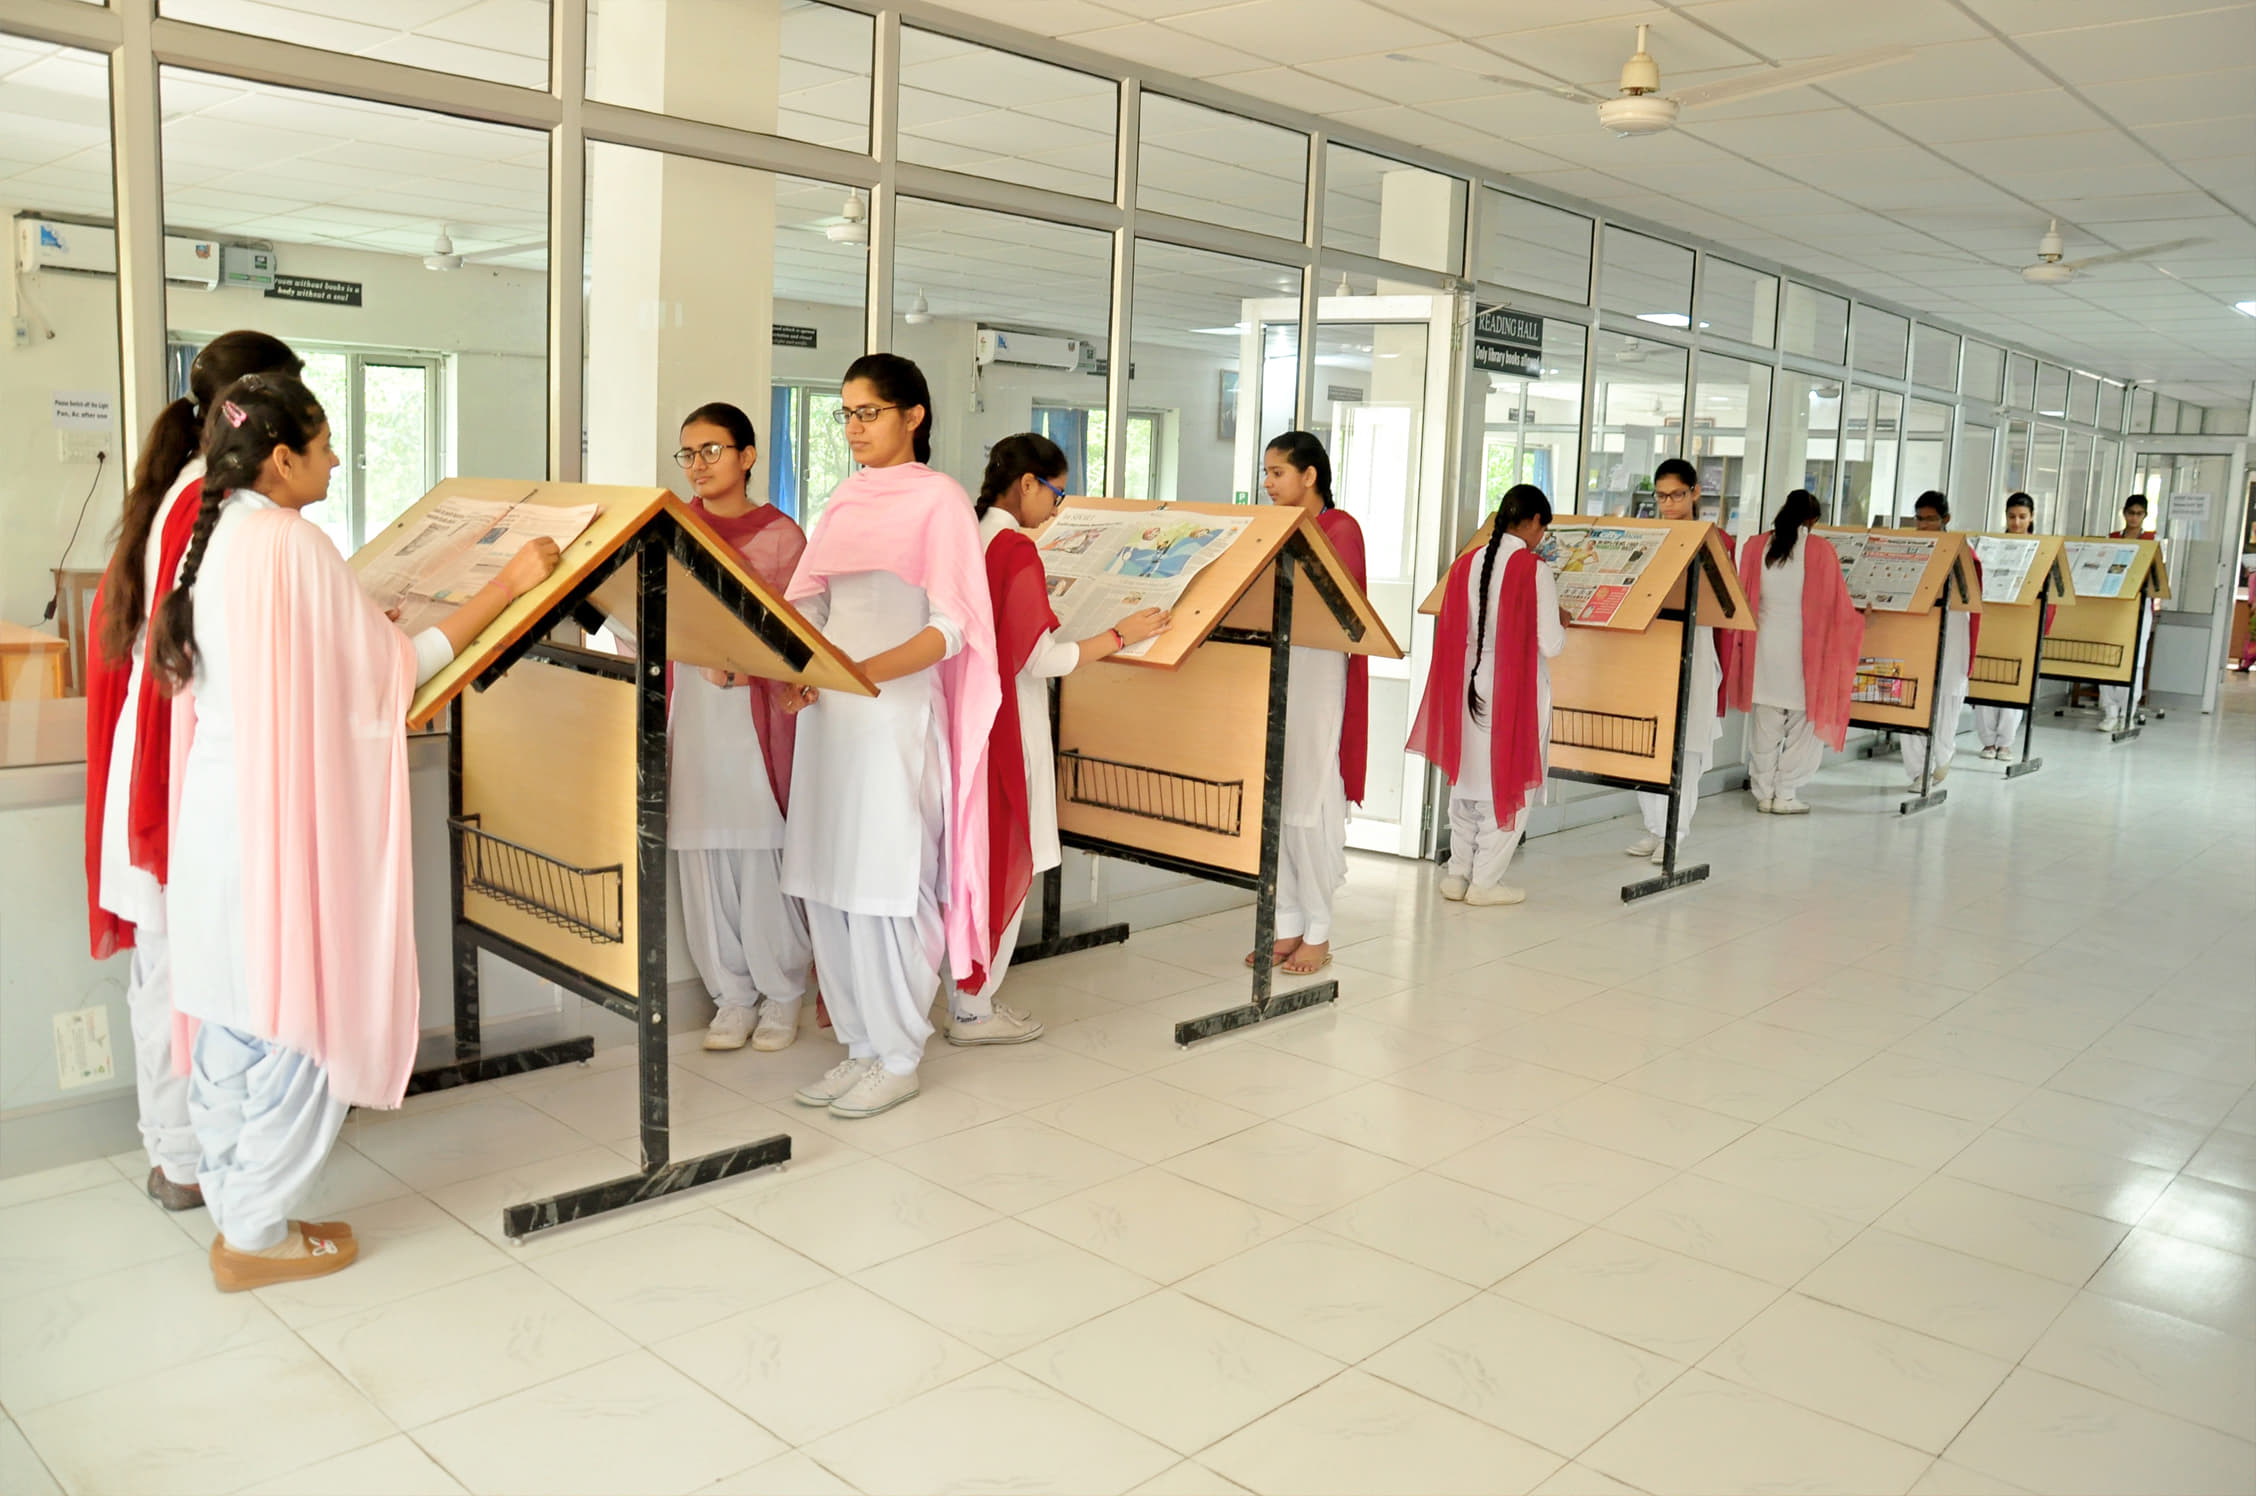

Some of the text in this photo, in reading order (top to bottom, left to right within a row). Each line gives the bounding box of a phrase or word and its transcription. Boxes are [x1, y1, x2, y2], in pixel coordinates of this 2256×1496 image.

[277, 286, 295, 296] body
[296, 289, 325, 299] without
[333, 293, 349, 301] soul
[294, 280, 323, 289] without
[324, 282, 345, 291] books
[1478, 312, 1539, 340] READING HALL
[1475, 345, 1488, 364] Only
[1488, 347, 1505, 367] library
[1505, 350, 1520, 366] books
